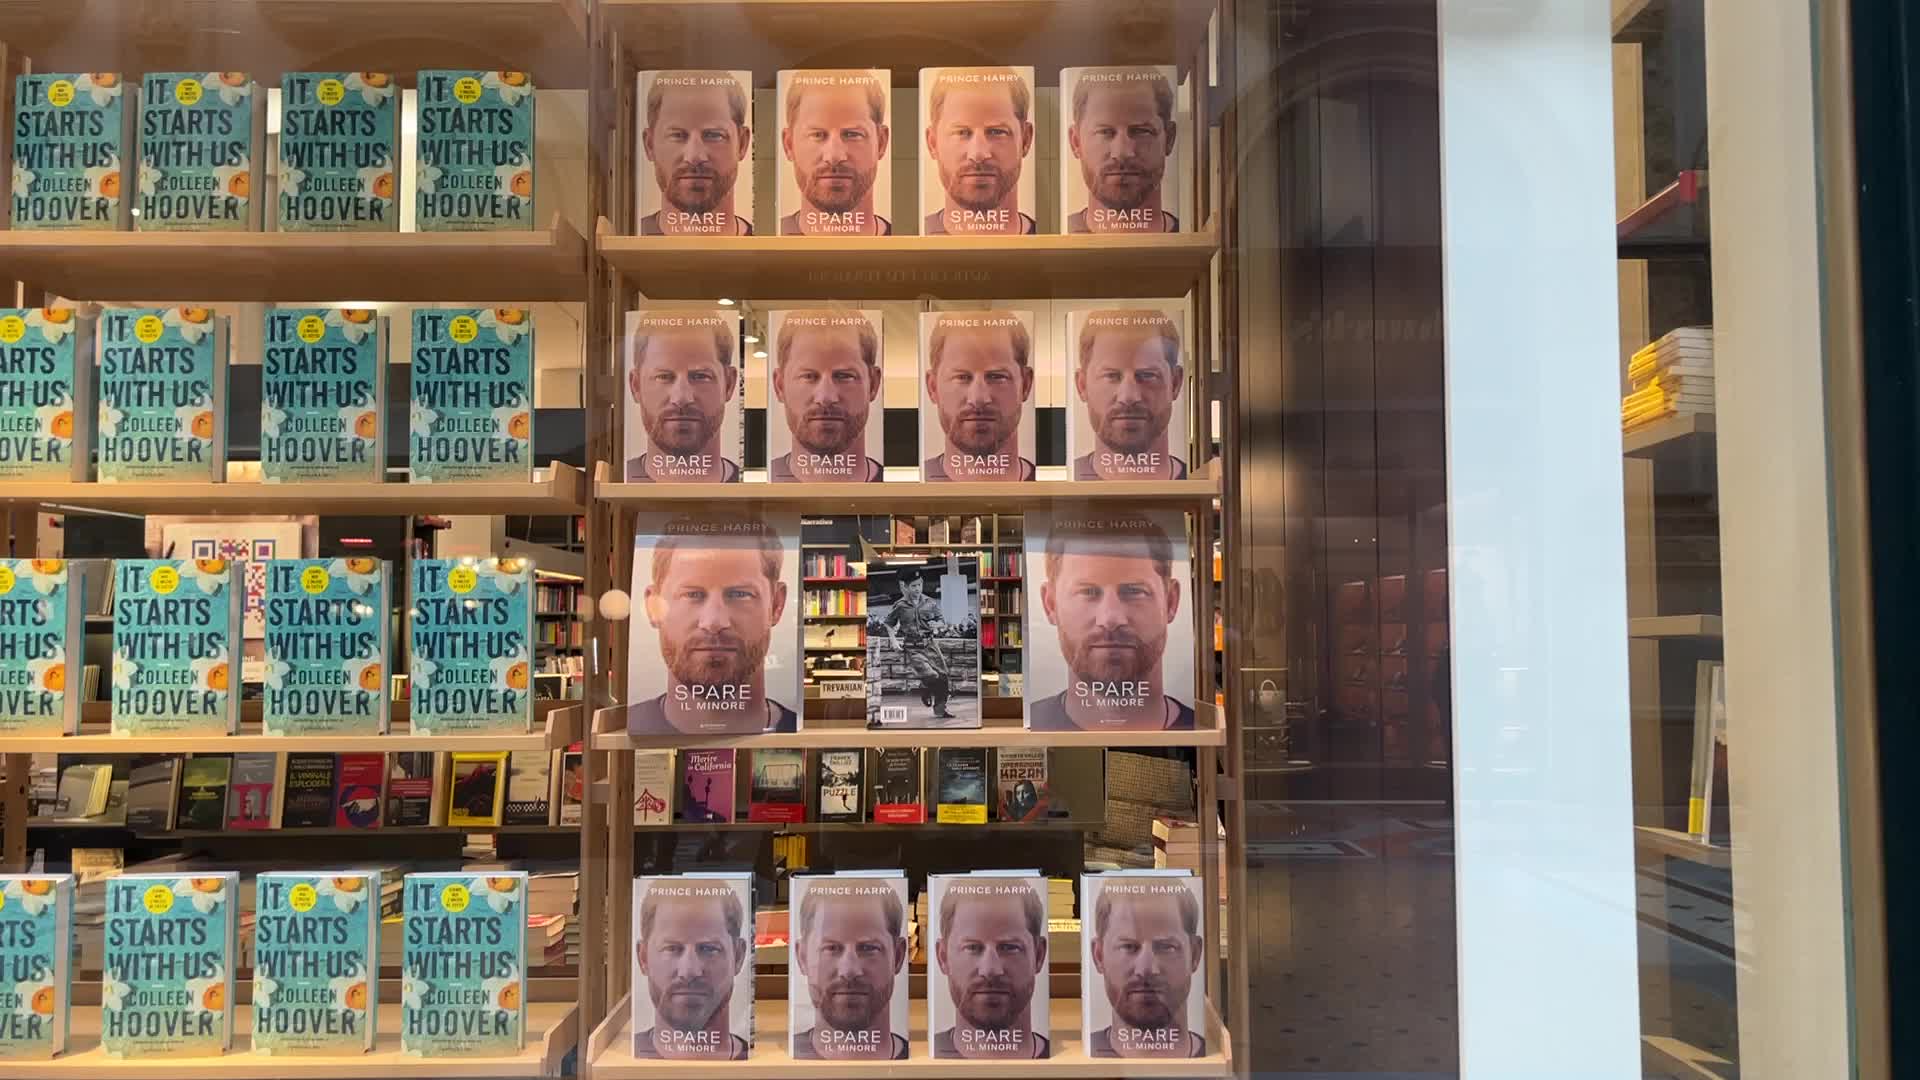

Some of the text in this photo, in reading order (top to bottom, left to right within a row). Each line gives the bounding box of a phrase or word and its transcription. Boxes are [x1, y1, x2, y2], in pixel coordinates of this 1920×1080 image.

[22, 80, 42, 106] IT
[149, 79, 168, 104] IT
[289, 79, 310, 104] IT
[426, 77, 447, 102] IT
[18, 111, 103, 137] STARTS
[145, 110, 232, 135] STARTS
[286, 110, 375, 136] STARTS
[422, 108, 512, 133] STARTS
[17, 142, 113, 168] WITH US
[144, 142, 241, 166] WITH US
[286, 142, 385, 168] WITH US
[422, 140, 523, 165] WITH US
[34, 178, 91, 192] COLLEEN
[161, 177, 220, 191] COLLEEN
[305, 178, 364, 192] COLLEEN
[441, 176, 502, 189] COLLEEN
[18, 196, 109, 220] HOOVER
[145, 196, 239, 220] HOOVER
[287, 196, 384, 220] HOOVER
[424, 194, 520, 219] HOOVER
[668, 212, 726, 224] SPARE
[807, 212, 864, 224] SPARE
[952, 210, 1009, 222] SPARE
[1095, 209, 1152, 221] SPARE
[107, 316, 128, 341] IT
[270, 316, 291, 341] IT
[420, 316, 442, 342] IT
[644, 318, 723, 326] PRINCE HARRY
[104, 348, 194, 374] STARTS
[267, 348, 356, 374] STARTS
[416, 348, 510, 374] STARTS
[104, 381, 205, 407] WITH US
[266, 381, 367, 408] WITH US
[416, 381, 520, 408] WITH US
[122, 418, 183, 432] COLLEEN
[286, 418, 346, 432] COLLEEN
[436, 418, 500, 432] COLLEEN
[105, 437, 201, 462] HOOVER
[268, 438, 365, 462] HOOVER
[418, 438, 519, 463] HOOVER
[653, 455, 712, 467] SPARE
[798, 455, 856, 466] SPARE
[951, 455, 1009, 467] SPARE
[1101, 453, 1160, 465] SPARE
[668, 524, 718, 532] PRINCE
[122, 567, 144, 592] IT
[272, 567, 293, 592] IT
[419, 567, 440, 592] IT
[119, 599, 210, 626] STARTS
[270, 599, 362, 626] STARTS
[416, 599, 508, 626] STARTS
[118, 633, 220, 659] WITH US
[269, 633, 372, 659] WITH US
[415, 632, 519, 658] WITH US
[136, 670, 198, 684] COLLEEN
[288, 670, 351, 684] COLLEEN
[436, 669, 497, 684] COLLEEN
[822, 683, 862, 692] TREVANIAN
[1075, 682, 1149, 696] SPARE
[119, 690, 217, 715] HOOVER
[271, 690, 369, 715] HOOVER
[418, 689, 516, 714] HOOVER
[675, 685, 752, 700] SPARE
[1082, 699, 1091, 707] IL
[681, 702, 745, 710] IL MINORE
[1001, 768, 1044, 779] KAZAN
[824, 788, 856, 796] PUZZLE
[114, 886, 136, 912] IT
[262, 883, 282, 909] IT
[413, 884, 434, 910] IT
[651, 888, 733, 896] PRINCE HARRY
[109, 919, 206, 945] STARTS
[258, 917, 347, 943] STARTS
[409, 918, 501, 944] STARTS
[109, 953, 216, 980] WITH US
[258, 951, 358, 978] WITH US
[408, 952, 512, 979] WITH US
[130, 991, 194, 1005] COLLEEN
[276, 989, 337, 1003] COLLEEN
[428, 990, 490, 1004] COLLEEN
[110, 1011, 213, 1036] HOOVER
[258, 1008, 355, 1034] HOOVER
[409, 1010, 509, 1035] HOOVER
[660, 1031, 720, 1044] SPARE
[820, 1031, 881, 1043] SPARE
[962, 1030, 1022, 1042] SPARE
[1118, 1029, 1178, 1041] SPARE
[664, 1044, 673, 1052] IL
[825, 1044, 833, 1052] IL
